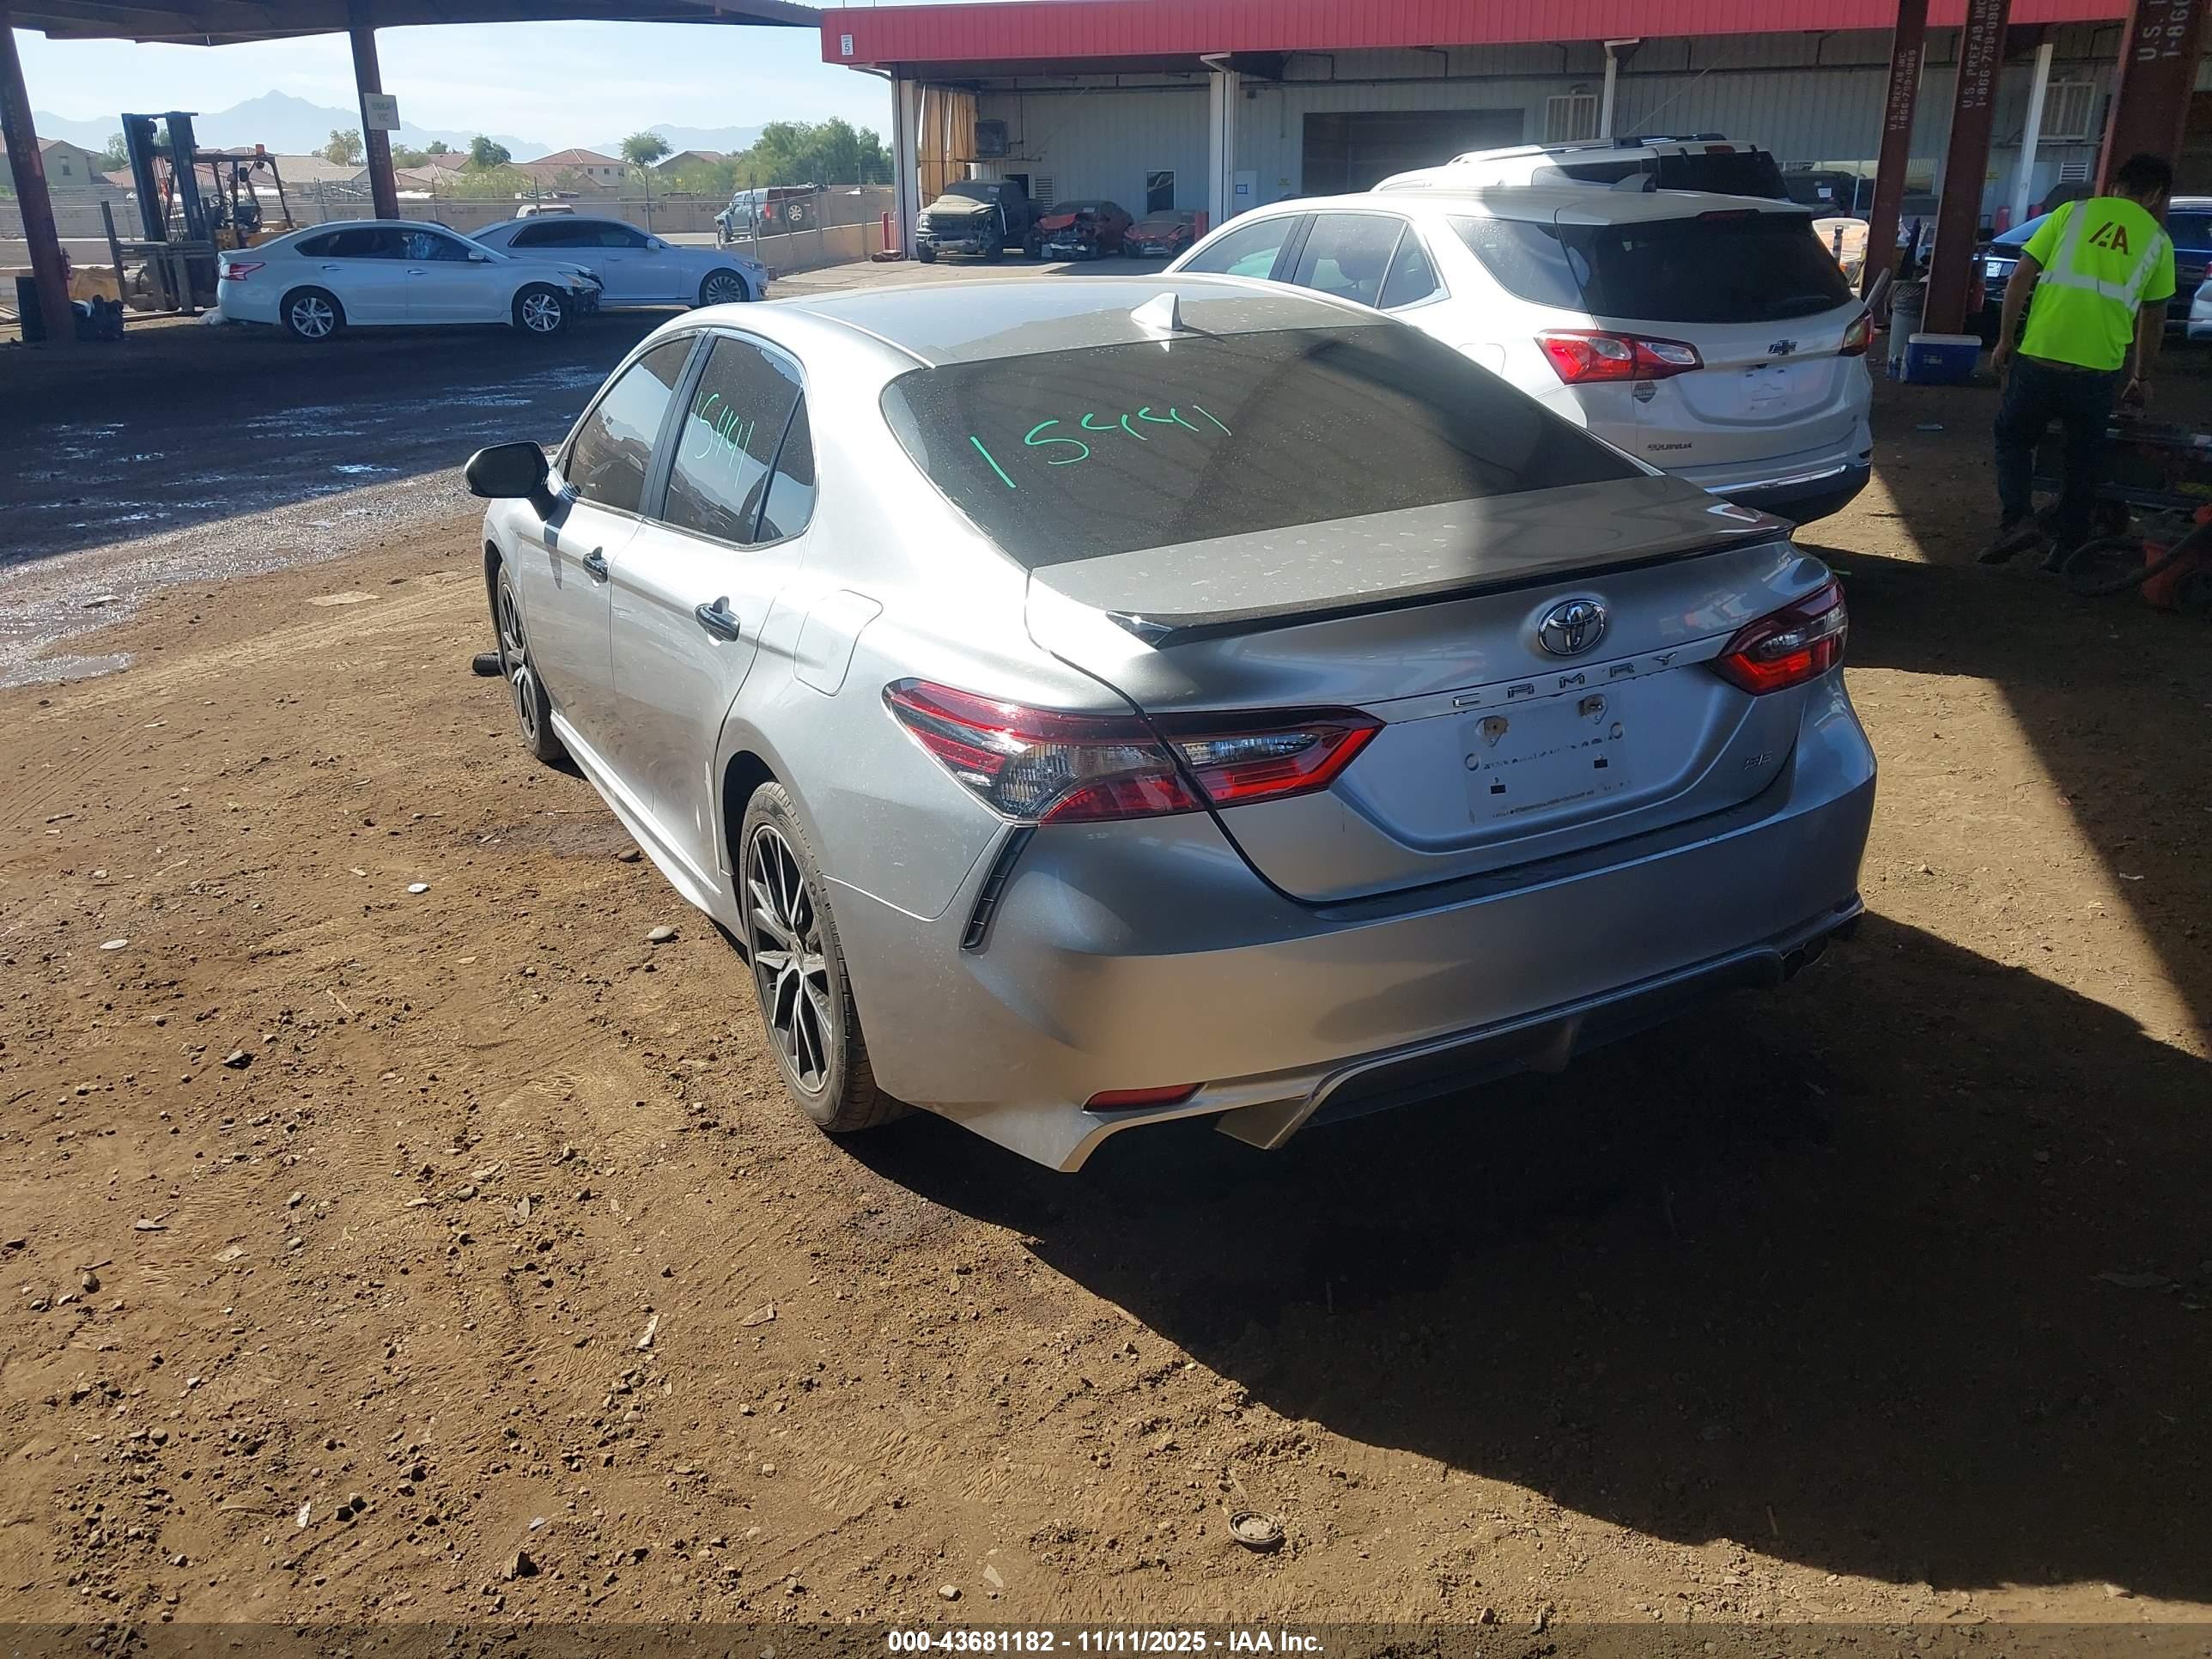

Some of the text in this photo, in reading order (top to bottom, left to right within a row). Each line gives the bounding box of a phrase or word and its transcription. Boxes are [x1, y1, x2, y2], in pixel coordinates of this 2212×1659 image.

[1966, 25, 1984, 76] PREFAB
[2137, 18, 2164, 61] U.S.
[680, 391, 755, 488] 15441
[969, 405, 1231, 488] 15441
[1453, 652, 1677, 708] CAMRY
[1744, 750, 1773, 769] SE
